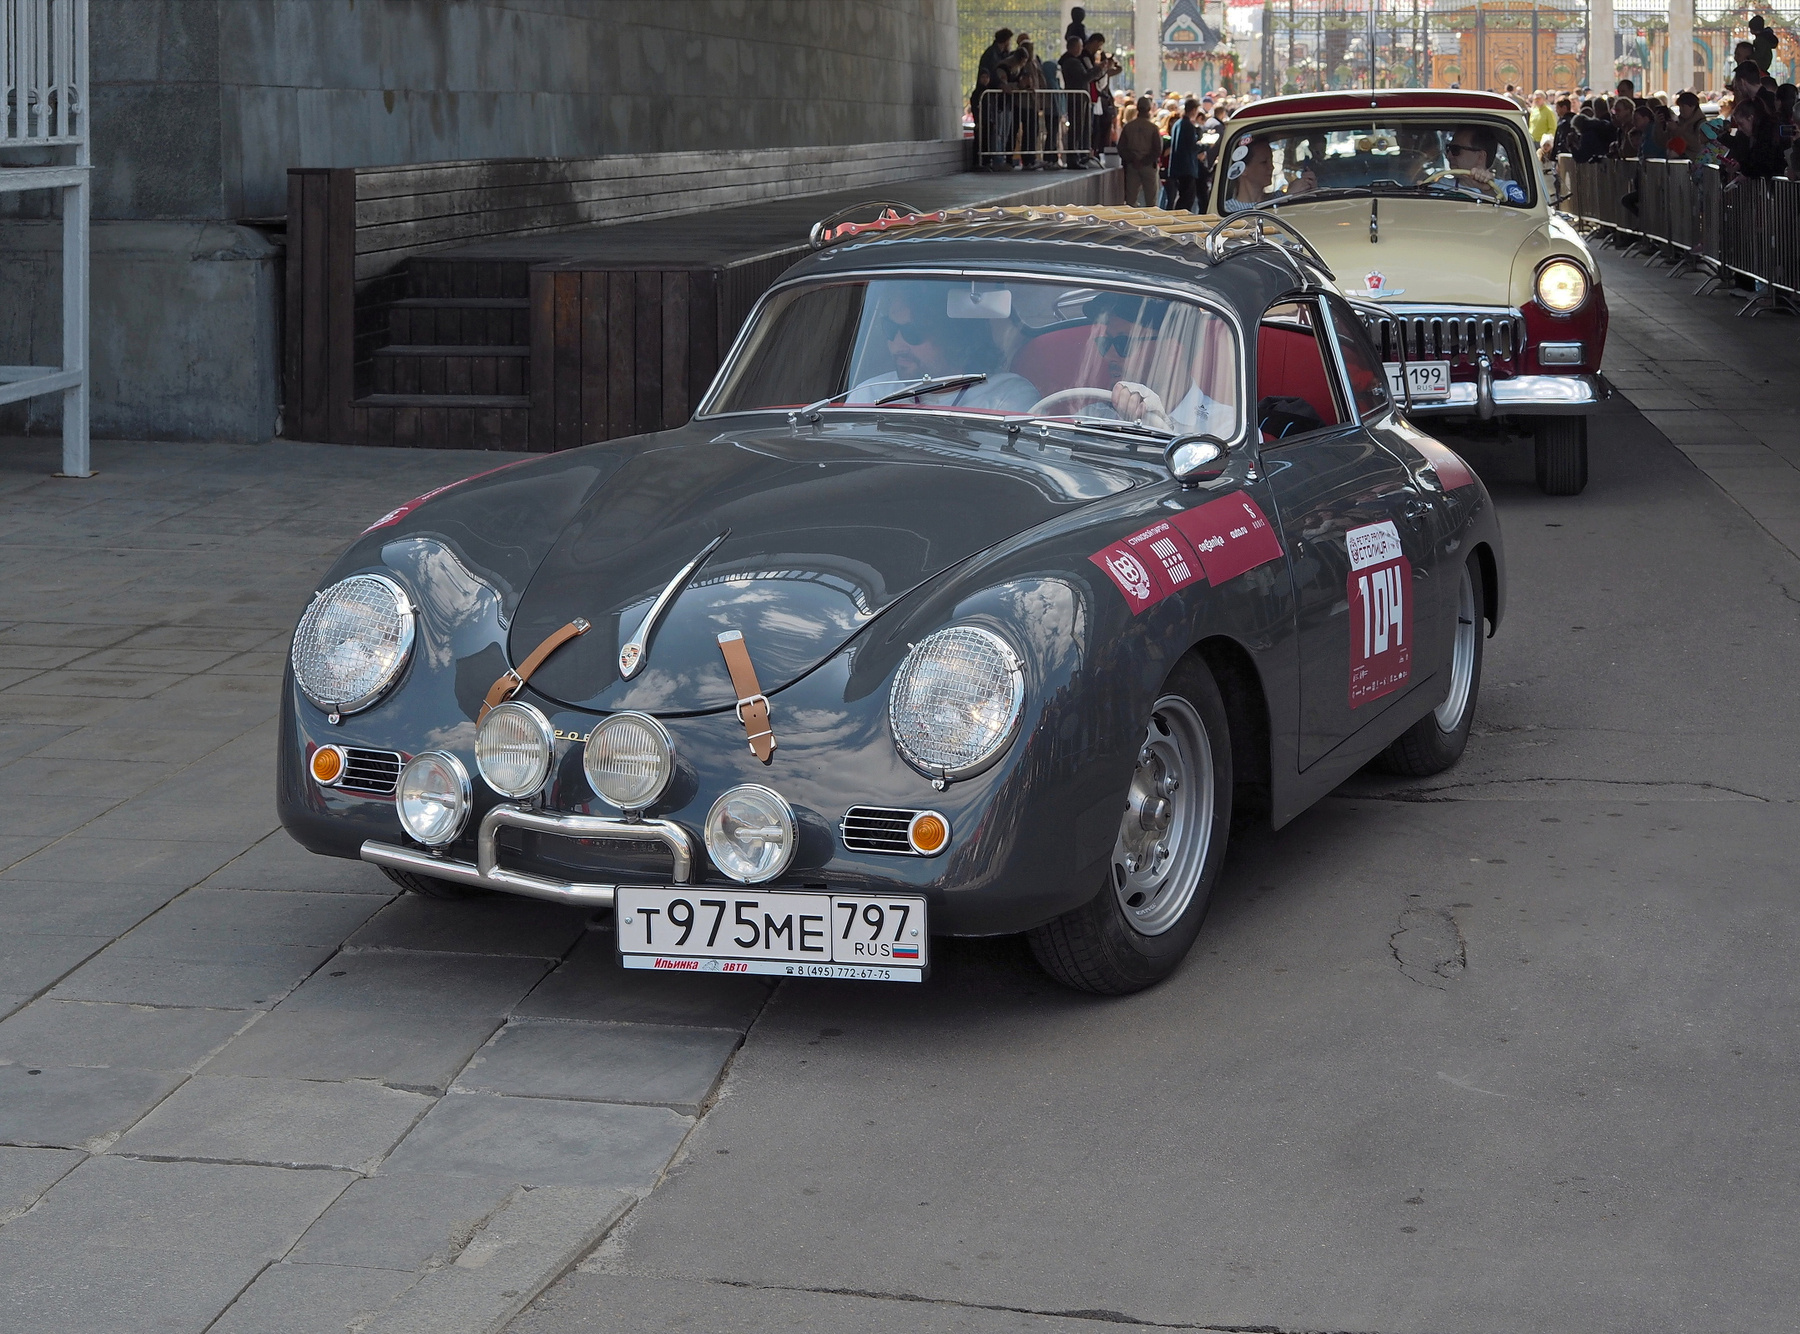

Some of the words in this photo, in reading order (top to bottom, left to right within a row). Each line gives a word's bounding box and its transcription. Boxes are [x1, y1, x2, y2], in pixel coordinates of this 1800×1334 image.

[1409, 367, 1441, 384] 199
[1358, 540, 1388, 560] СТОЛИЦА
[1358, 564, 1403, 660] 104
[837, 902, 910, 941] 797
[854, 942, 890, 956] RUS
[654, 957, 699, 970] Ильинка
[722, 962, 748, 972] авто
[797, 966, 804, 975] 8
[807, 965, 834, 977] (495)
[837, 968, 891, 980] 772-67-75
